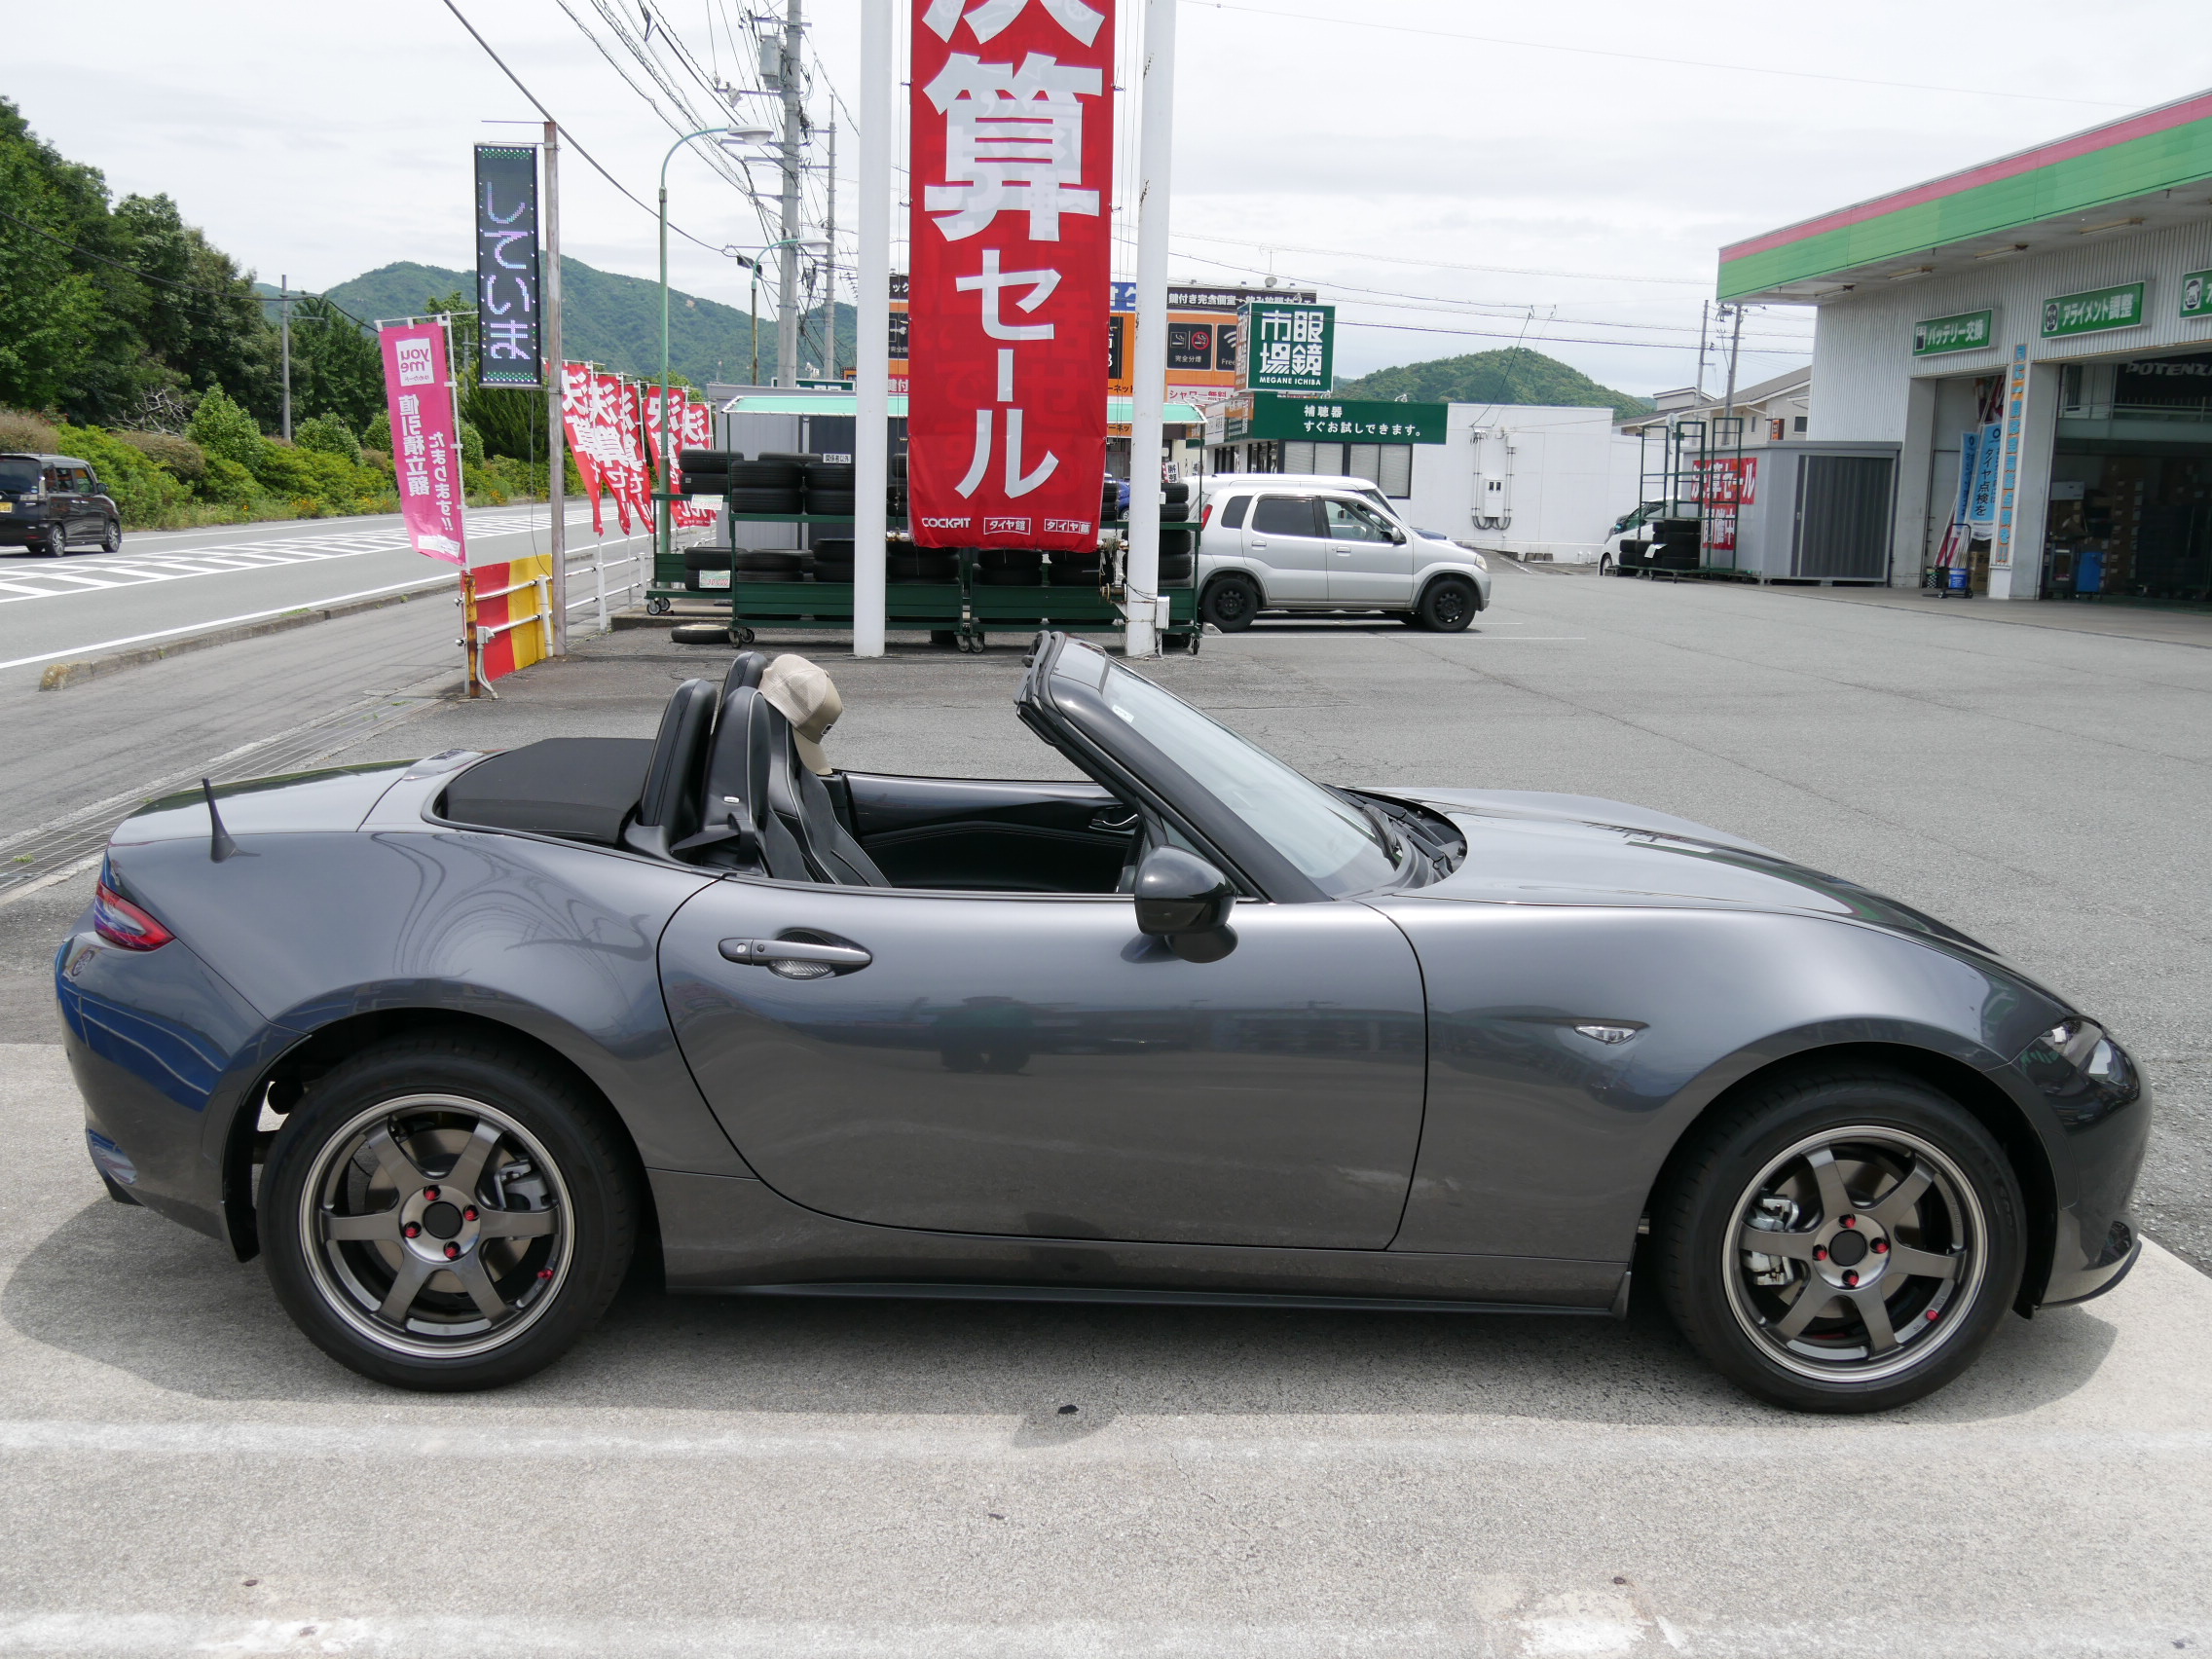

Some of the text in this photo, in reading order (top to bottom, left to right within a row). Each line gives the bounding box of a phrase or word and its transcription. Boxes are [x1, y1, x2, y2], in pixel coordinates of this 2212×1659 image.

[922, 0, 1106, 498] 算セール
[2062, 293, 2134, 327] アライメント調整
[1927, 319, 1984, 345] バッテリー交換
[2125, 362, 2212, 376] POTENZ
[1304, 405, 1343, 418] 補聴器
[1304, 420, 1420, 437] すぐお試しできます。
[921, 518, 971, 529] COCKPIT
[989, 520, 1025, 531] タイヤ館
